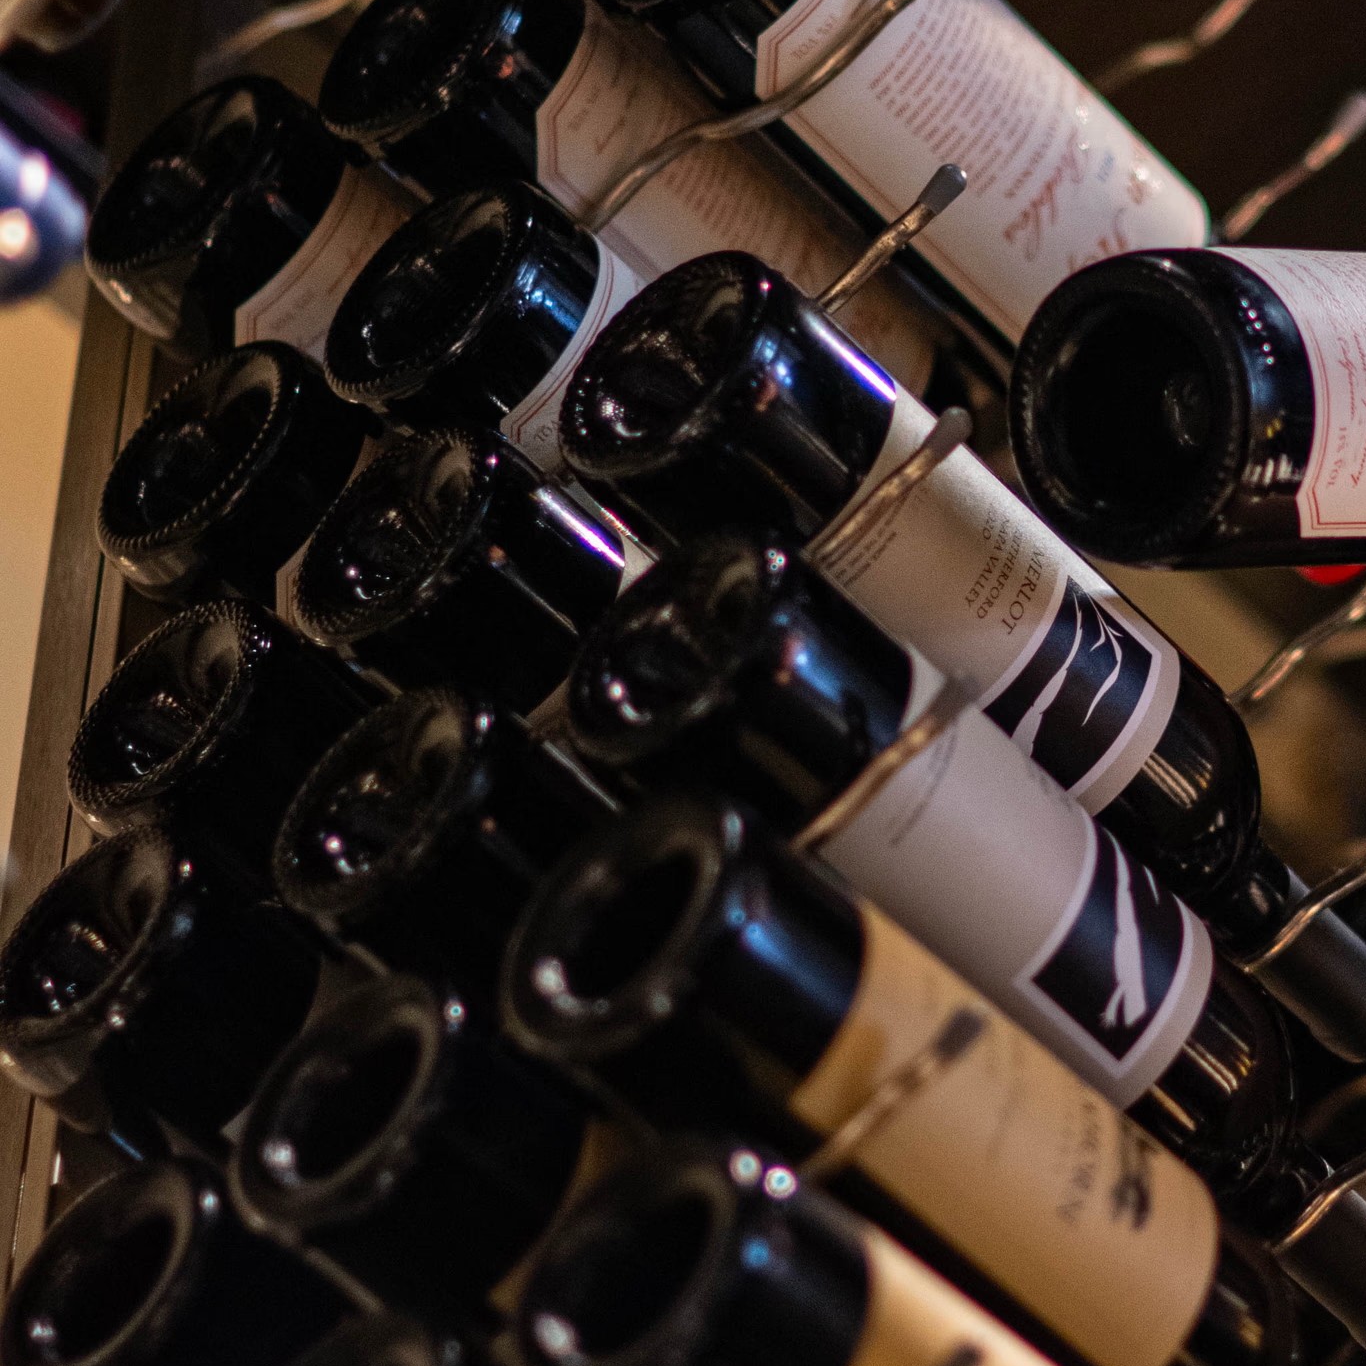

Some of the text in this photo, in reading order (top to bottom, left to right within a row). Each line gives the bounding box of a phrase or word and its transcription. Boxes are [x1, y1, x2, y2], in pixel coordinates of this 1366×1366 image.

[965, 515, 1011, 607] NAPA VALLEY
[977, 523, 1024, 619] UTHERFORD
[1002, 544, 1045, 634] MERLOT
